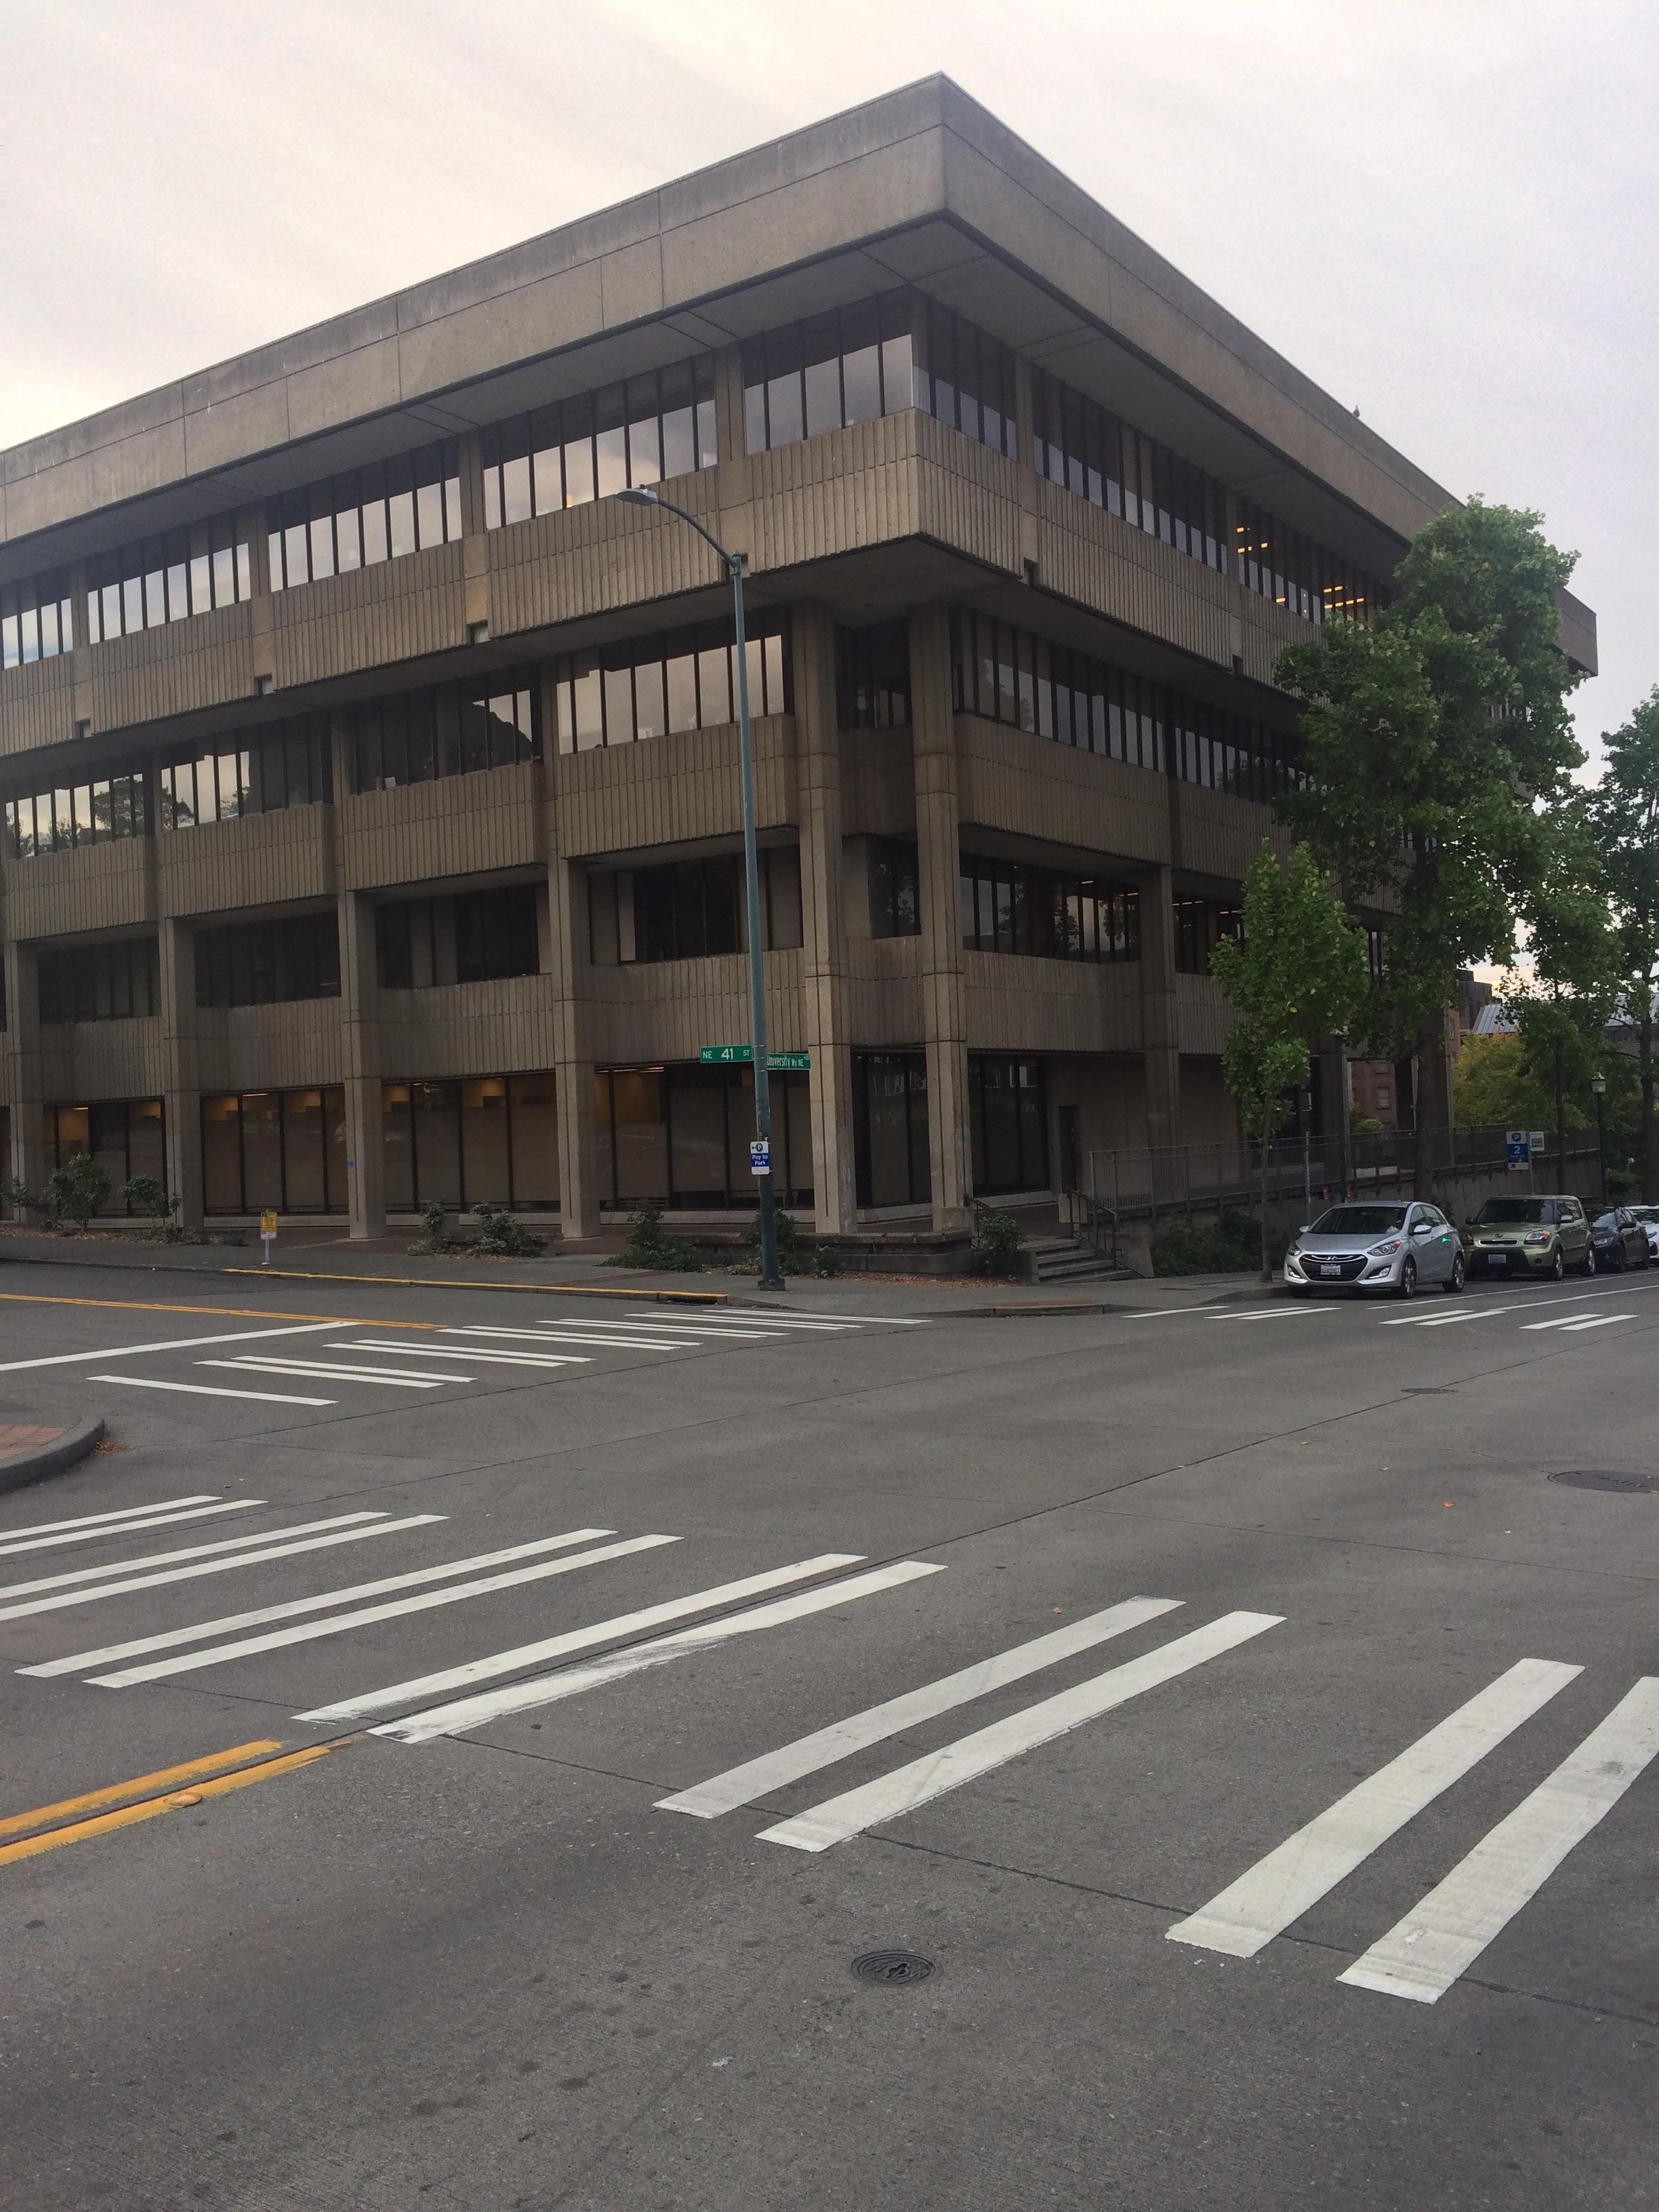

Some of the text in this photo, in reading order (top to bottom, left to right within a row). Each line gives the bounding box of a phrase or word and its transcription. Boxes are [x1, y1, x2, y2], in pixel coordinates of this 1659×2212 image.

[702, 1050, 713, 1059] NE
[720, 1048, 734, 1061] 41
[766, 1054, 791, 1068] University
[798, 1059, 804, 1067] NE
[1514, 1145, 1521, 1154] 2
